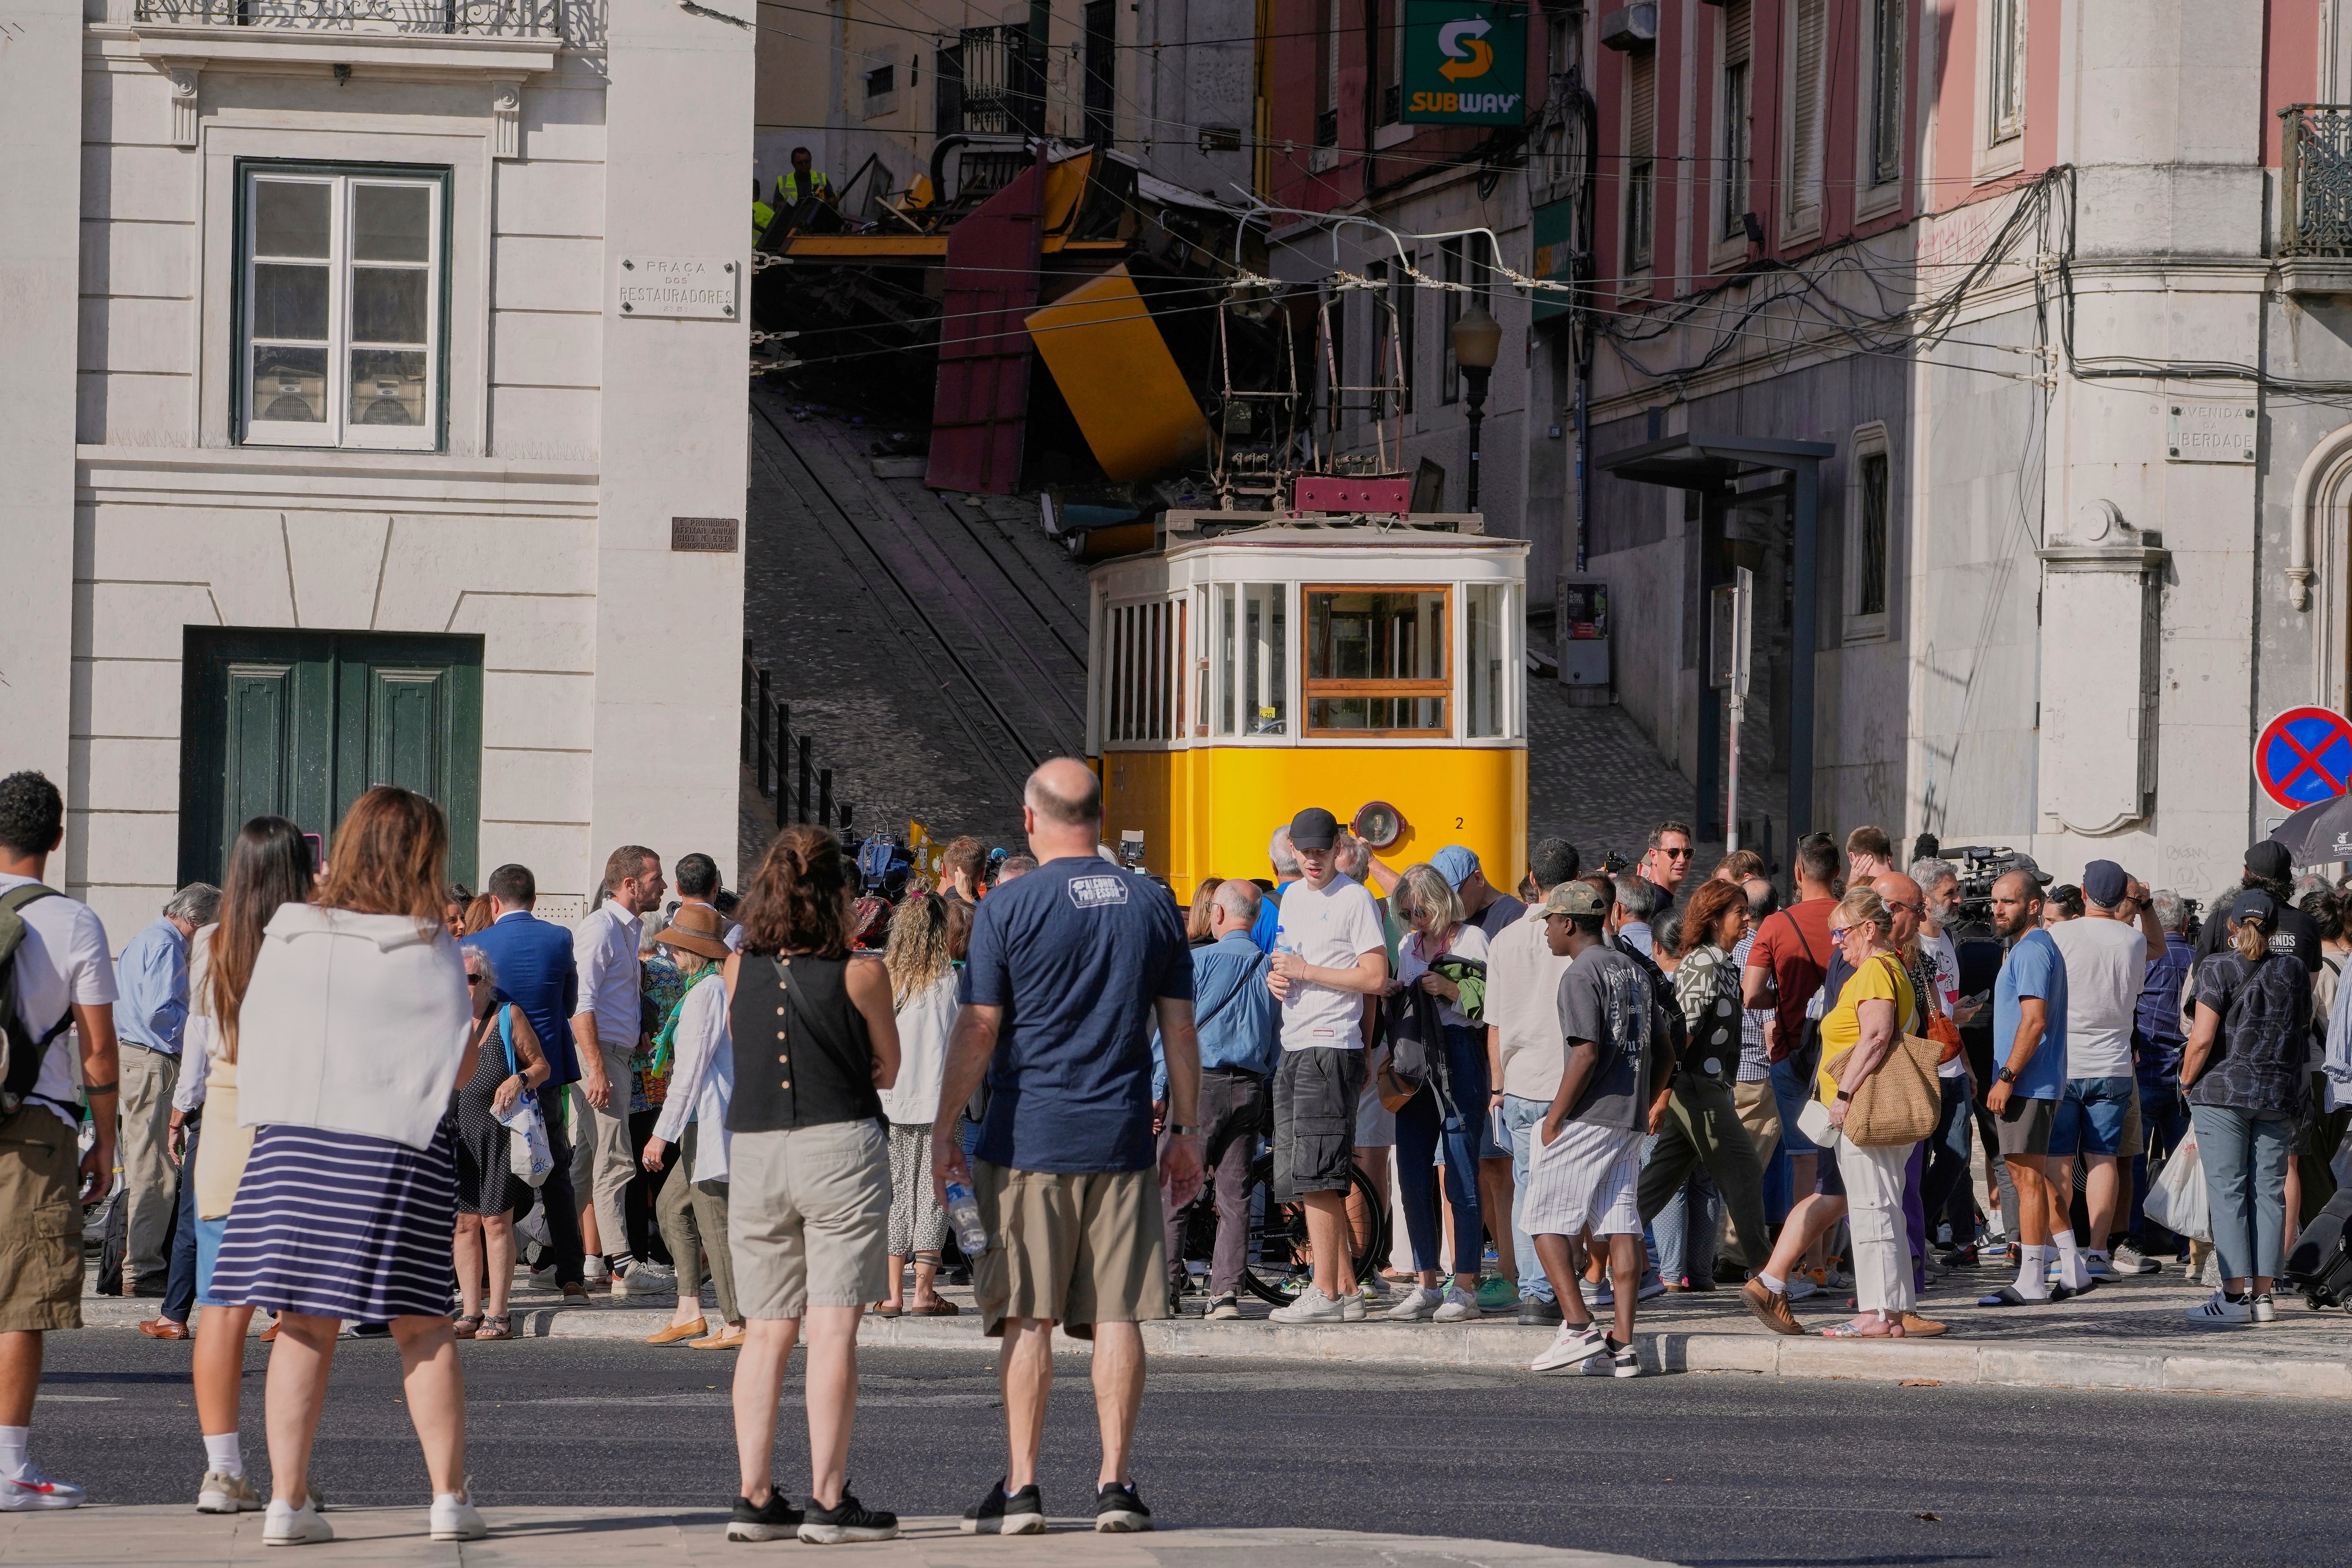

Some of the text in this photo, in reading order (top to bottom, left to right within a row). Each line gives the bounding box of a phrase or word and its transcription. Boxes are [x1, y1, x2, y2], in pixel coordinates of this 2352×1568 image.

[1408, 92, 1521, 113] SUBWAY
[647, 261, 706, 276] PRAÇA
[620, 287, 732, 304] RESTAURADORES
[2180, 407, 2244, 419] AVENIDA
[2167, 432, 2253, 448] LIBERDADE
[1455, 817, 1464, 829] 2
